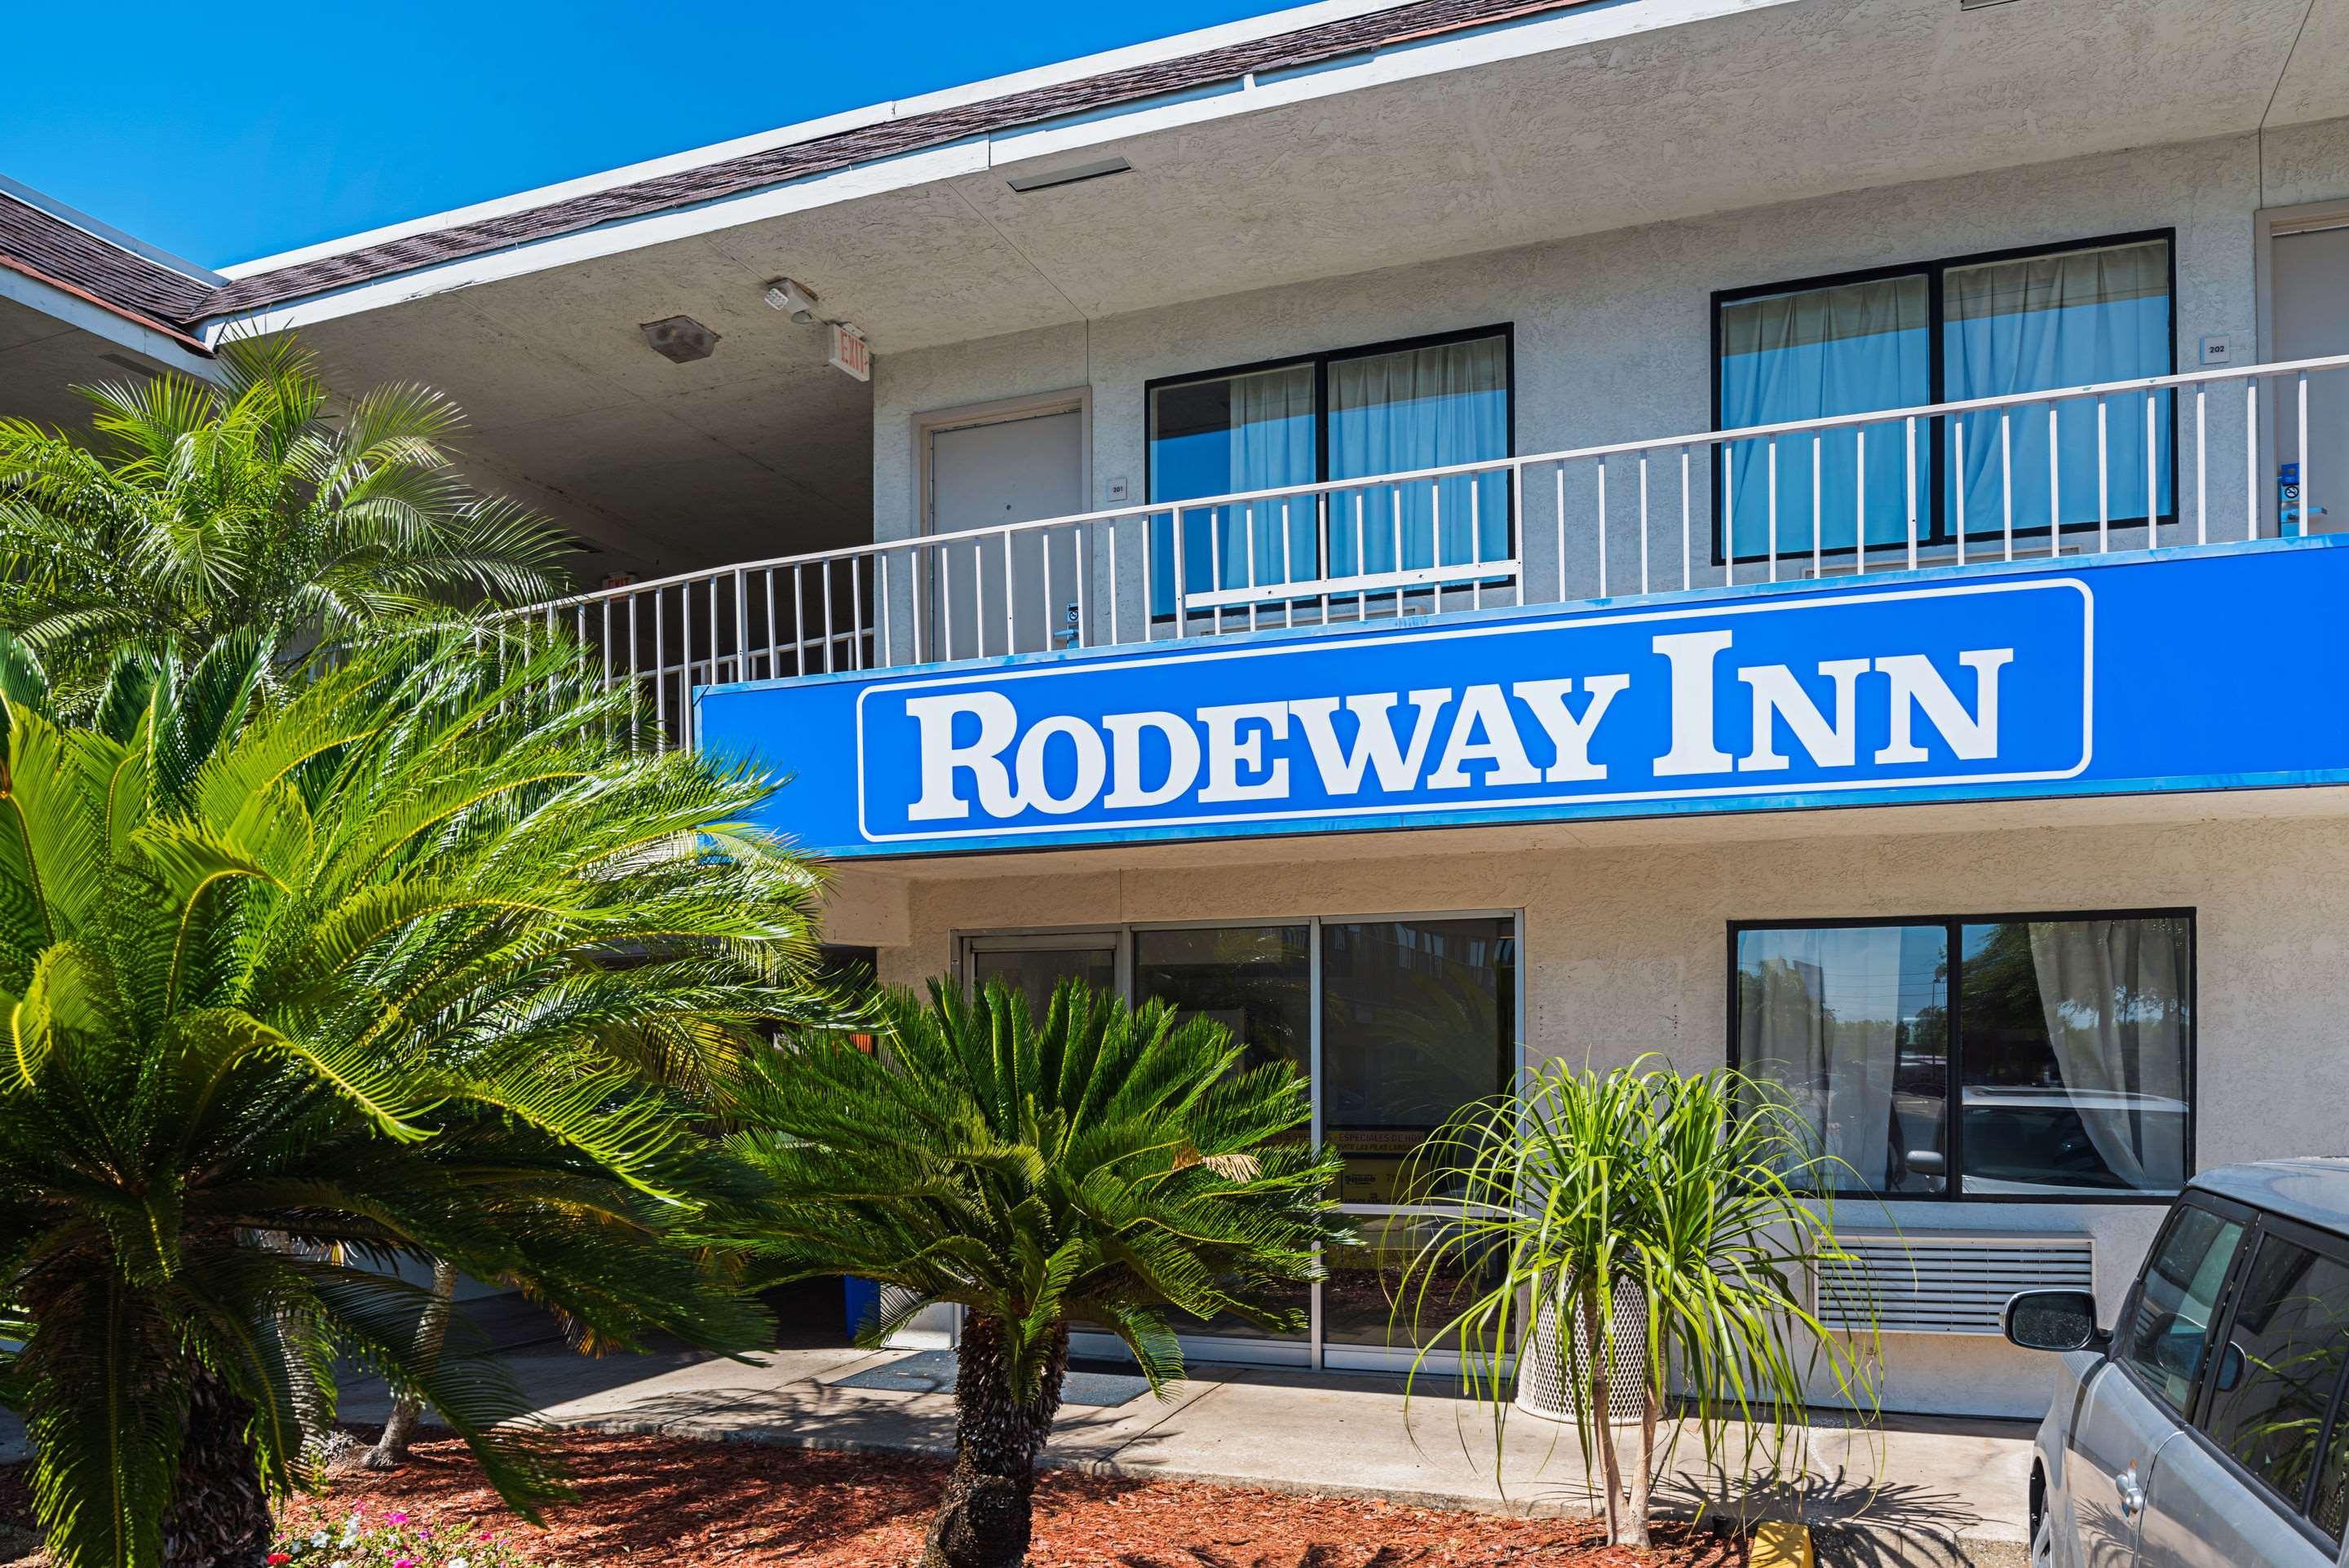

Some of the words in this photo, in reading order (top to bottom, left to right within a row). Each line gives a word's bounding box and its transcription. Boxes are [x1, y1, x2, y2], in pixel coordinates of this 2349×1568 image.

[840, 329, 866, 373] EXIT
[2209, 345, 2225, 354] 202
[905, 673, 1630, 821] RODEWAY
[1652, 629, 2014, 777] INN
[1338, 1133, 1388, 1142] ESPECIALES
